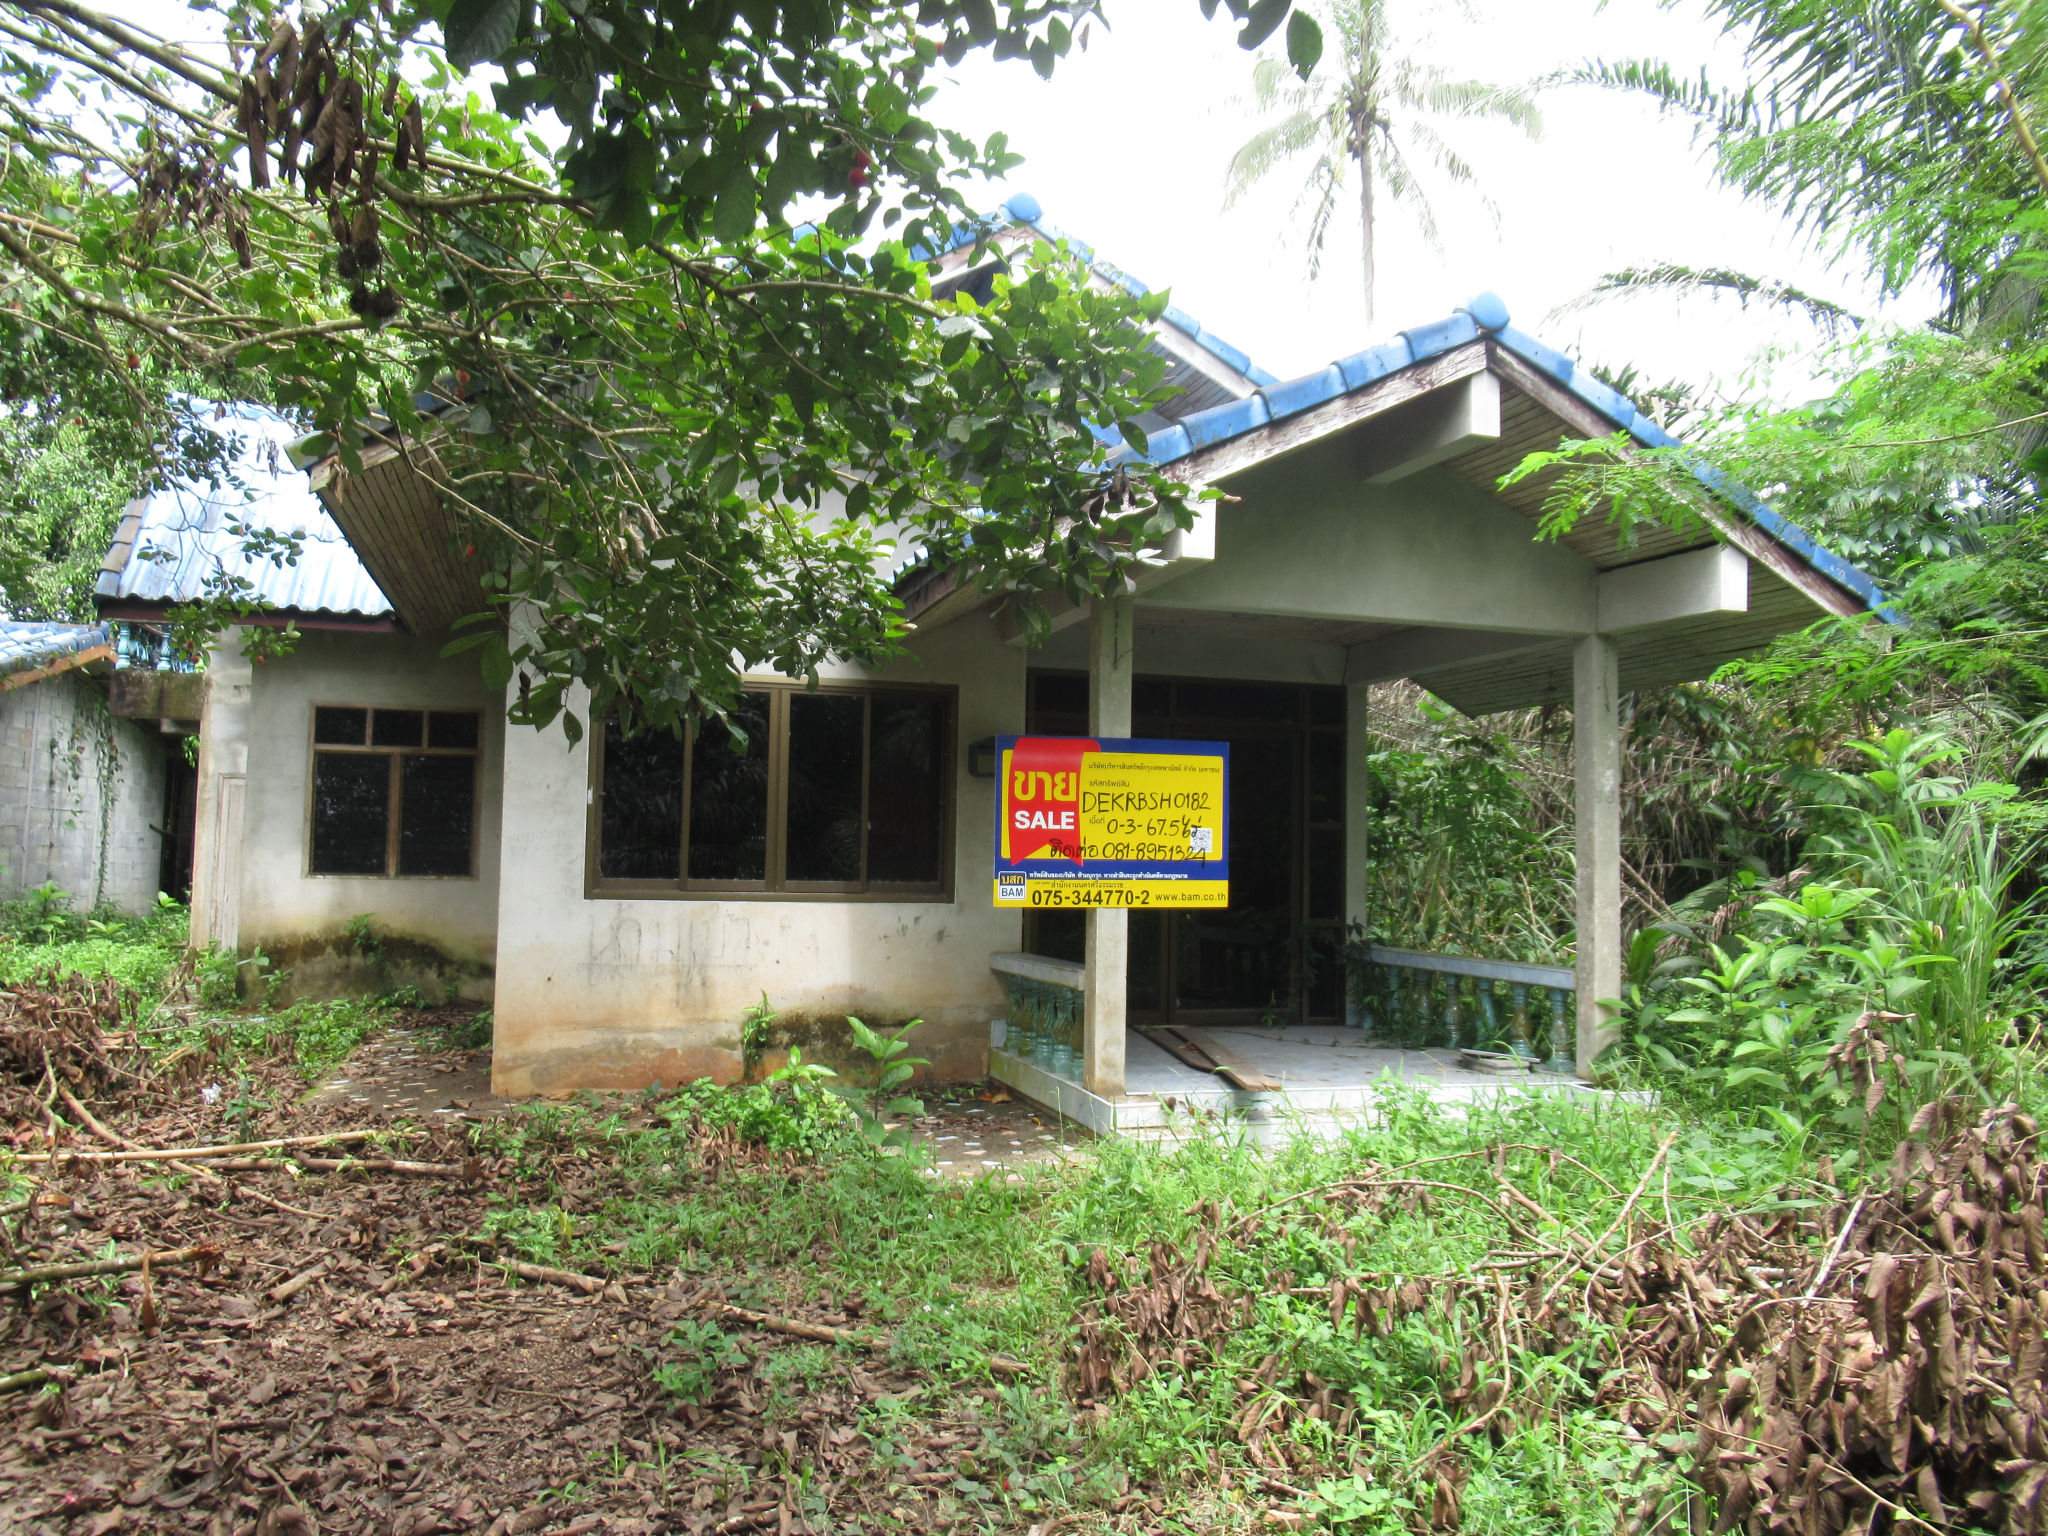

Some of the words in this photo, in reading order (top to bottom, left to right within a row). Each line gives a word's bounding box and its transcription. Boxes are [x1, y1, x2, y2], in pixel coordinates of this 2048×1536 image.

[1014, 770, 1077, 802] ขาย
[1089, 779, 1130, 788] รหัสทรัพย์สิน
[1082, 791, 1211, 814] DEKRBSH0182
[1014, 810, 1075, 830] SALE
[1089, 815, 1106, 825] เนื้อที่
[1049, 837, 1099, 859] ติดต่อ
[1001, 875, 1024, 885] บสก
[1001, 888, 1024, 897] BAM
[1031, 889, 1150, 906] 075-344770-2
[1155, 893, 1227, 902] www.bam.co.th
